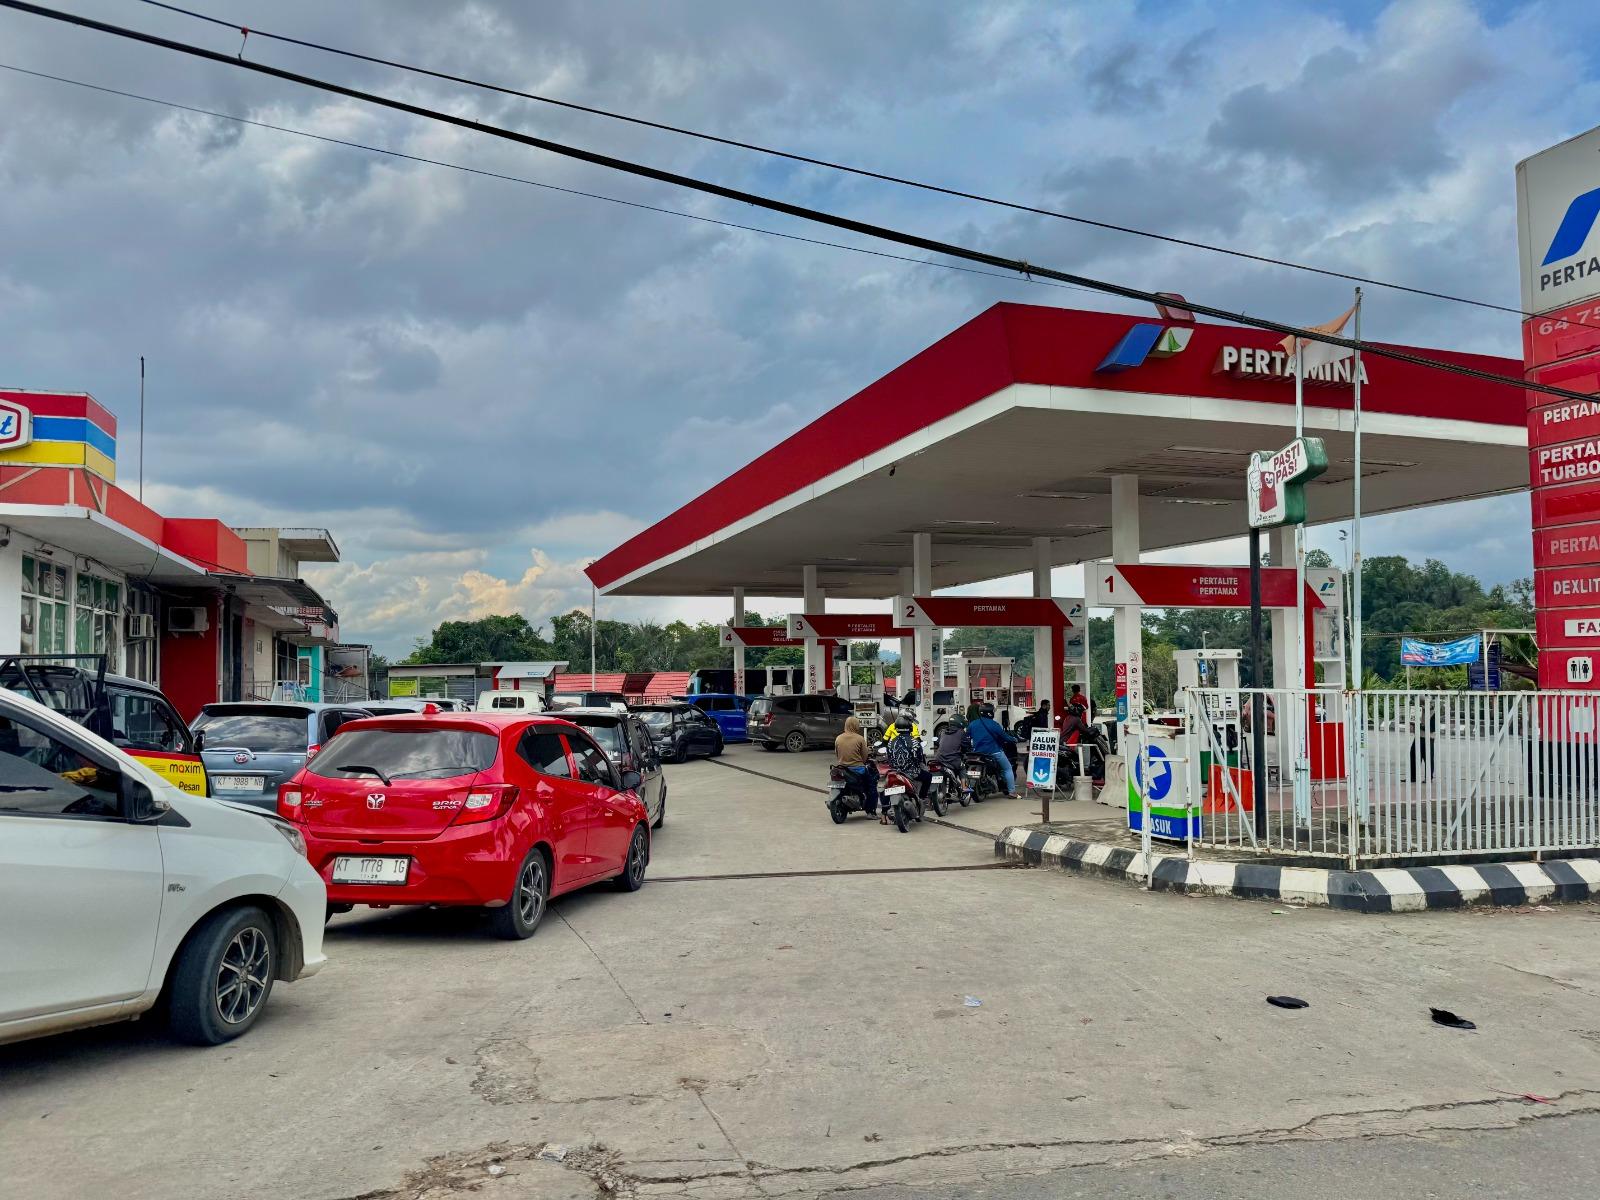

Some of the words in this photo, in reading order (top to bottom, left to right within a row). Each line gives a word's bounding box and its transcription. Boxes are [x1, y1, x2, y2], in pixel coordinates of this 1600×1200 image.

[1273, 442, 1300, 471] PASTI
[1540, 441, 1600, 465] PERTA
[1275, 458, 1297, 484] PAS!
[1541, 459, 1600, 483] TURBO
[1550, 535, 1600, 555] PERTA
[1105, 576, 1114, 593] 1
[1199, 577, 1239, 586] PERTALITE
[1199, 587, 1239, 596] PERTAMAX
[905, 605, 916, 618] 2
[973, 605, 1006, 613] PERTAMAX
[796, 620, 804, 631] 3
[1577, 622, 1600, 634] FA
[725, 634, 733, 643] 4
[1032, 736, 1057, 744] JALUR
[1031, 743, 1056, 752] BBM
[169, 763, 201, 774] maxim
[178, 781, 201, 792] Pesan
[1149, 817, 1172, 835] ASUK
[335, 858, 351, 872] KT
[360, 859, 384, 873] 1778
[393, 860, 405, 874] IG
